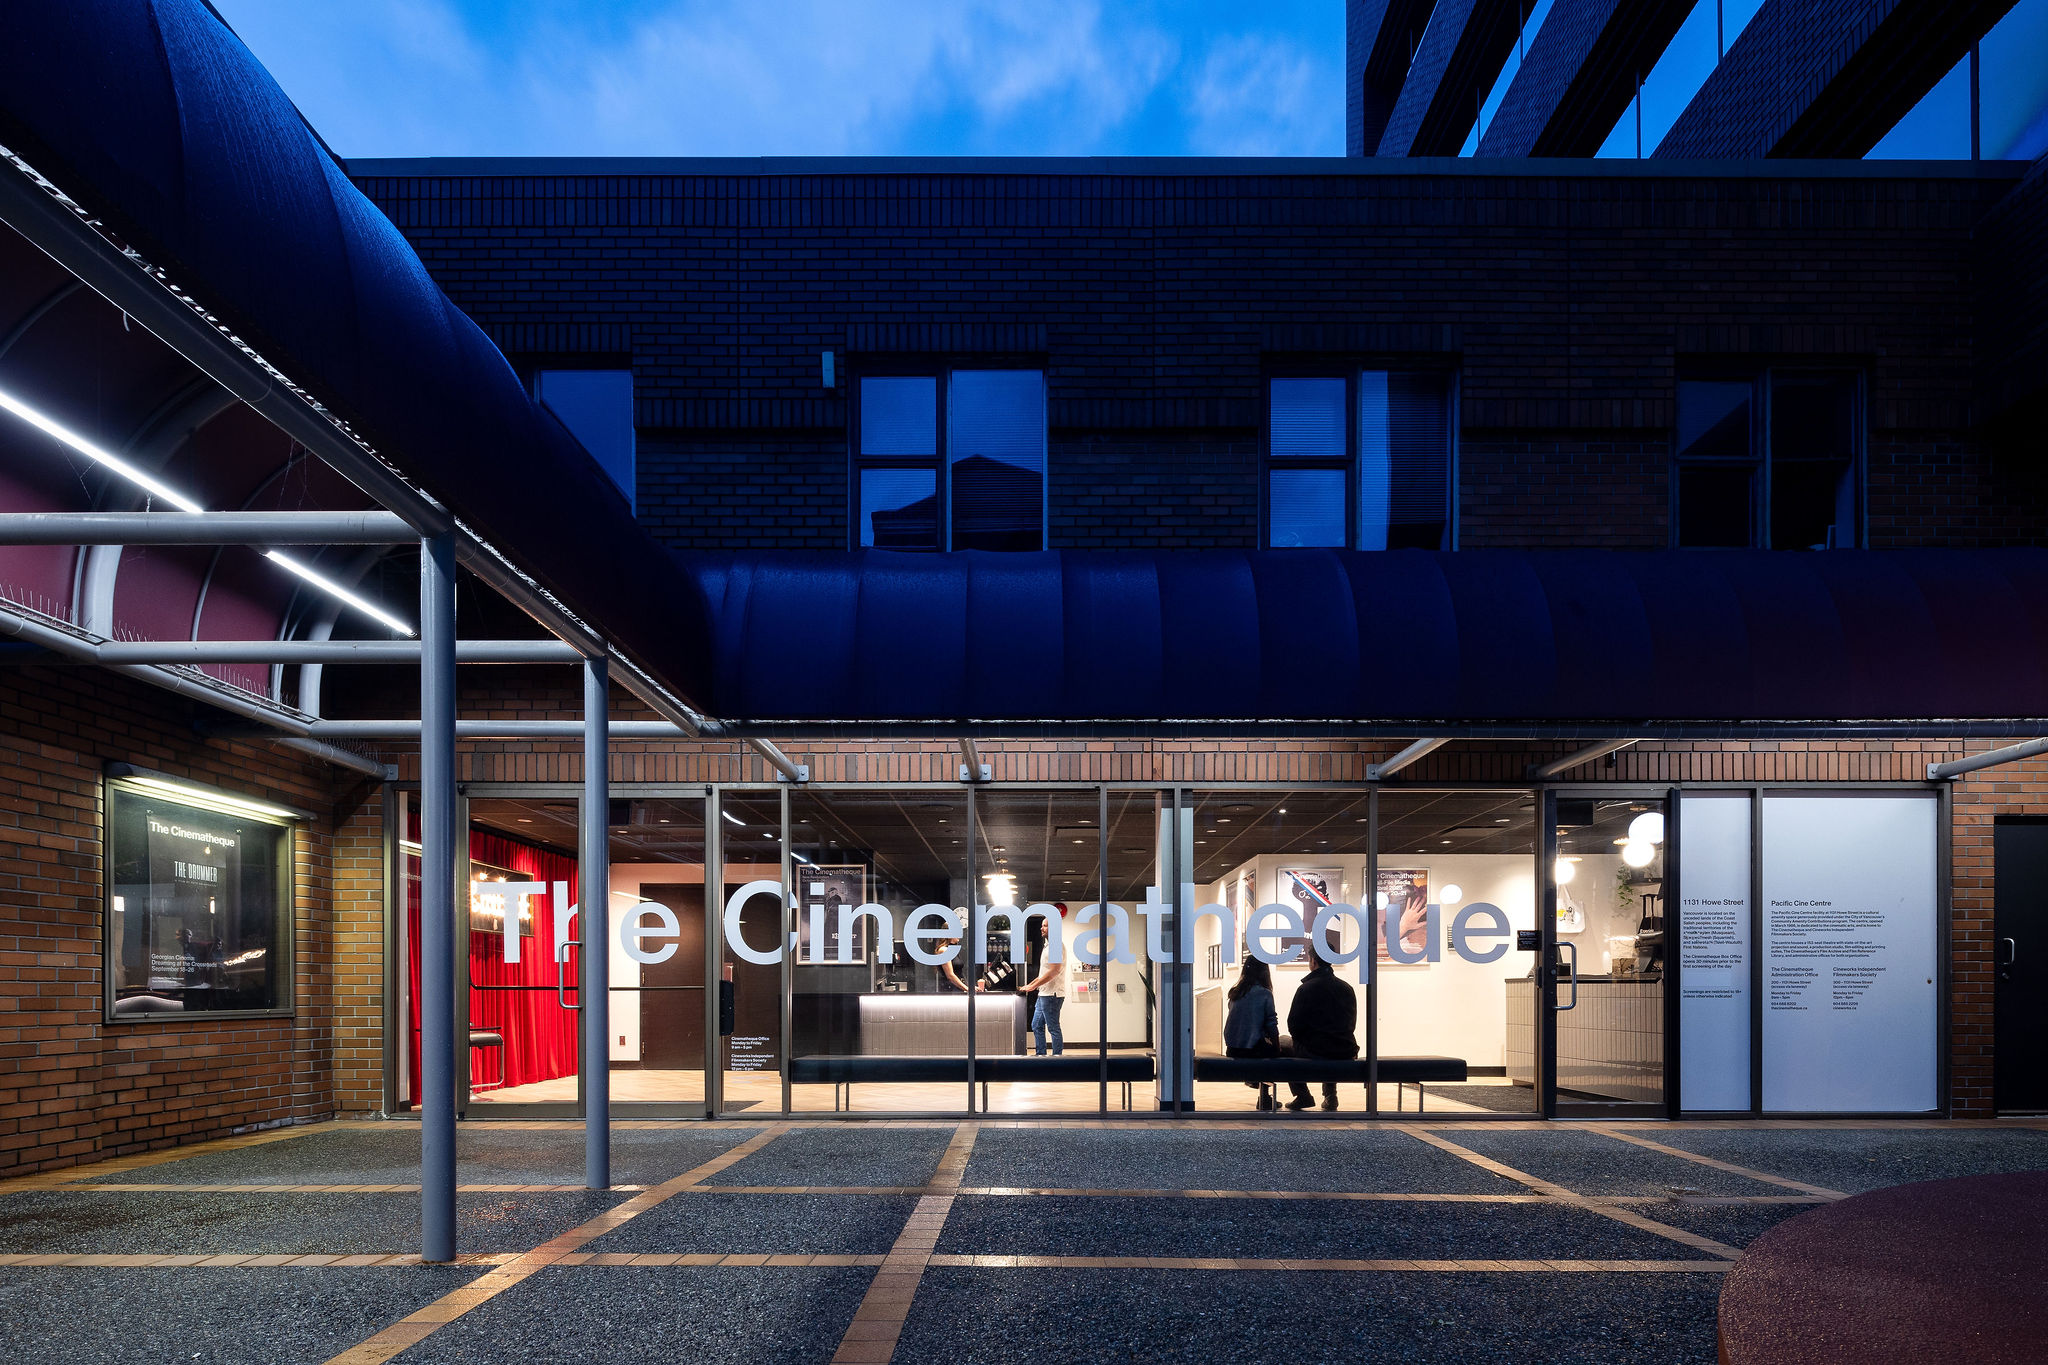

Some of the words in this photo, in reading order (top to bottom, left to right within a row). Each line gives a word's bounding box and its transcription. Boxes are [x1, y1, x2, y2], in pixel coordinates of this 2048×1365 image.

[150, 821, 169, 834] The
[170, 826, 235, 848] Cinematheque
[174, 860, 186, 878] THE
[188, 862, 218, 882] DRUMMER
[815, 868, 862, 877] Cinematheque
[476, 880, 681, 964] The
[723, 880, 1511, 984] Cinematheque
